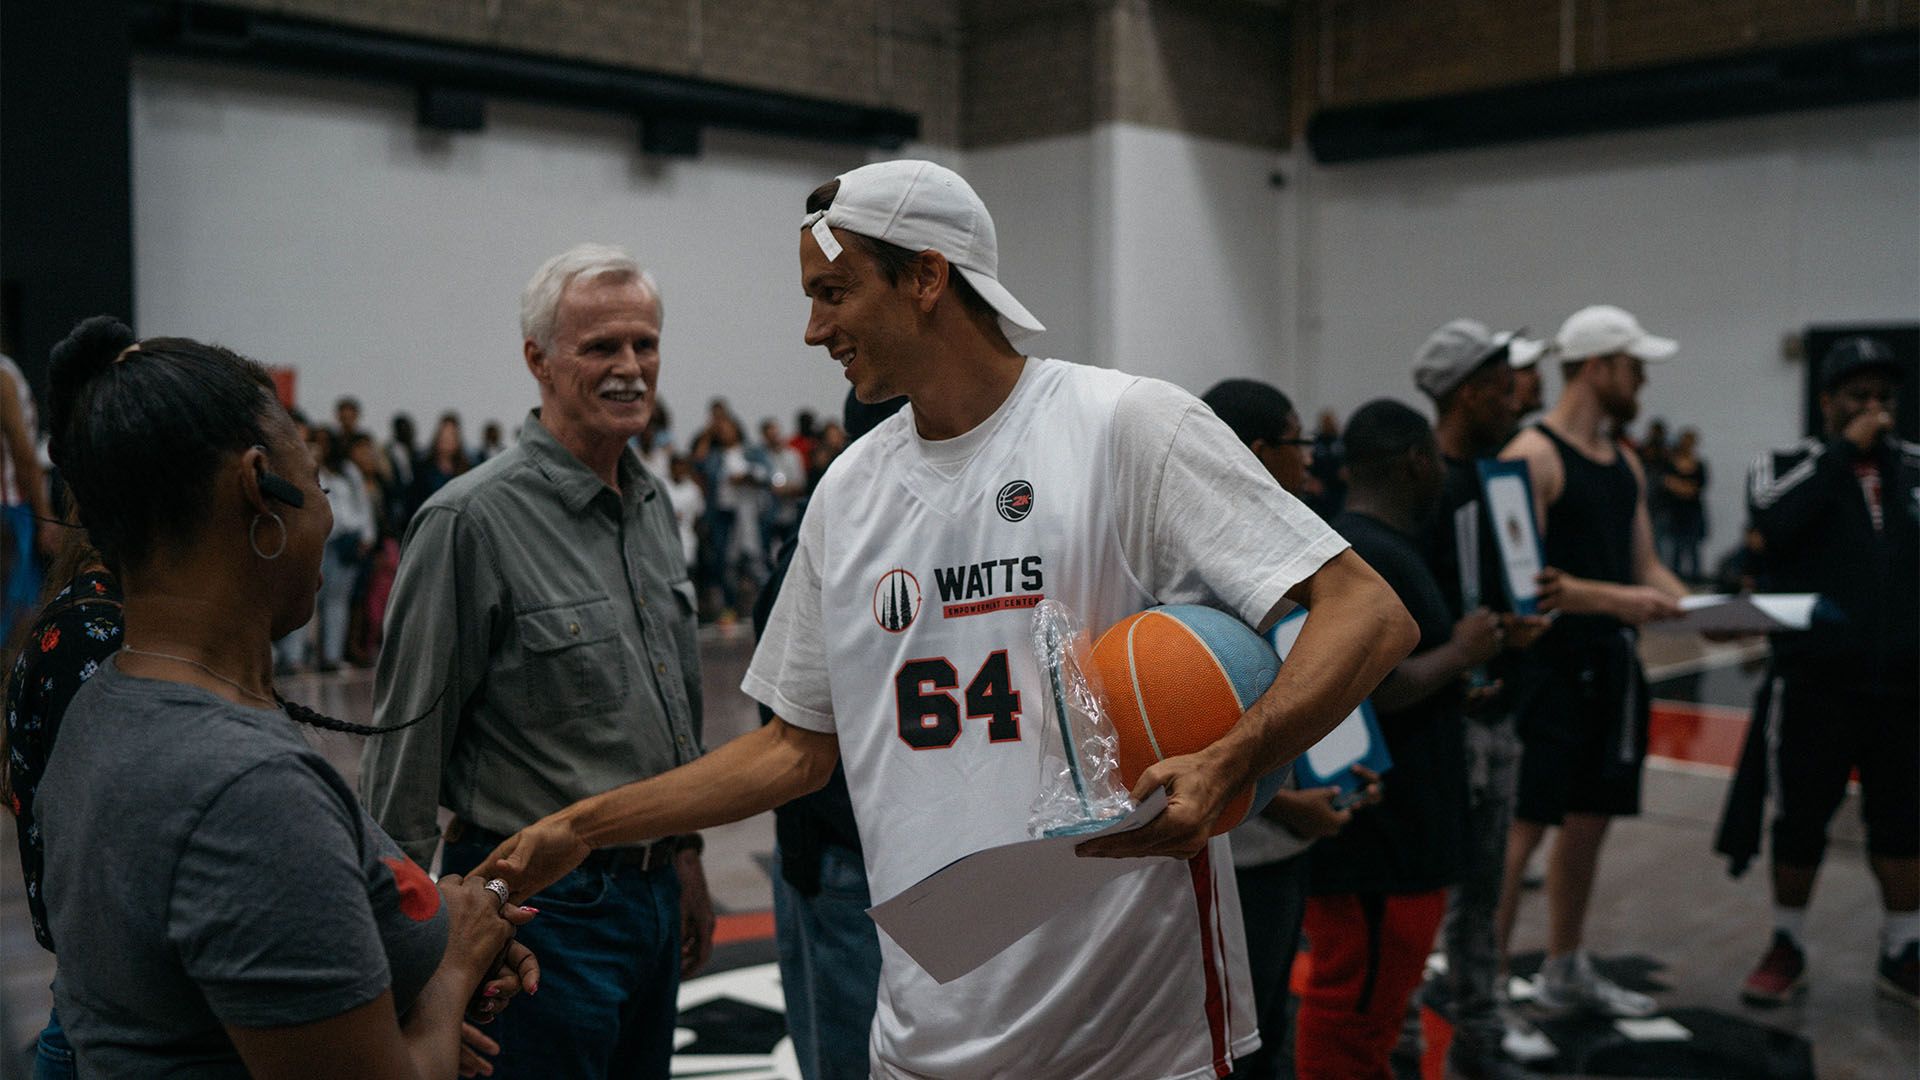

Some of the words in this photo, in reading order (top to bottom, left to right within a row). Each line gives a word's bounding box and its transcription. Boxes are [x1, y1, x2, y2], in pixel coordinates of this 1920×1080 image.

[1012, 494, 1029, 507] 2K
[934, 556, 1043, 602] WATTS
[895, 649, 1022, 751] 64
